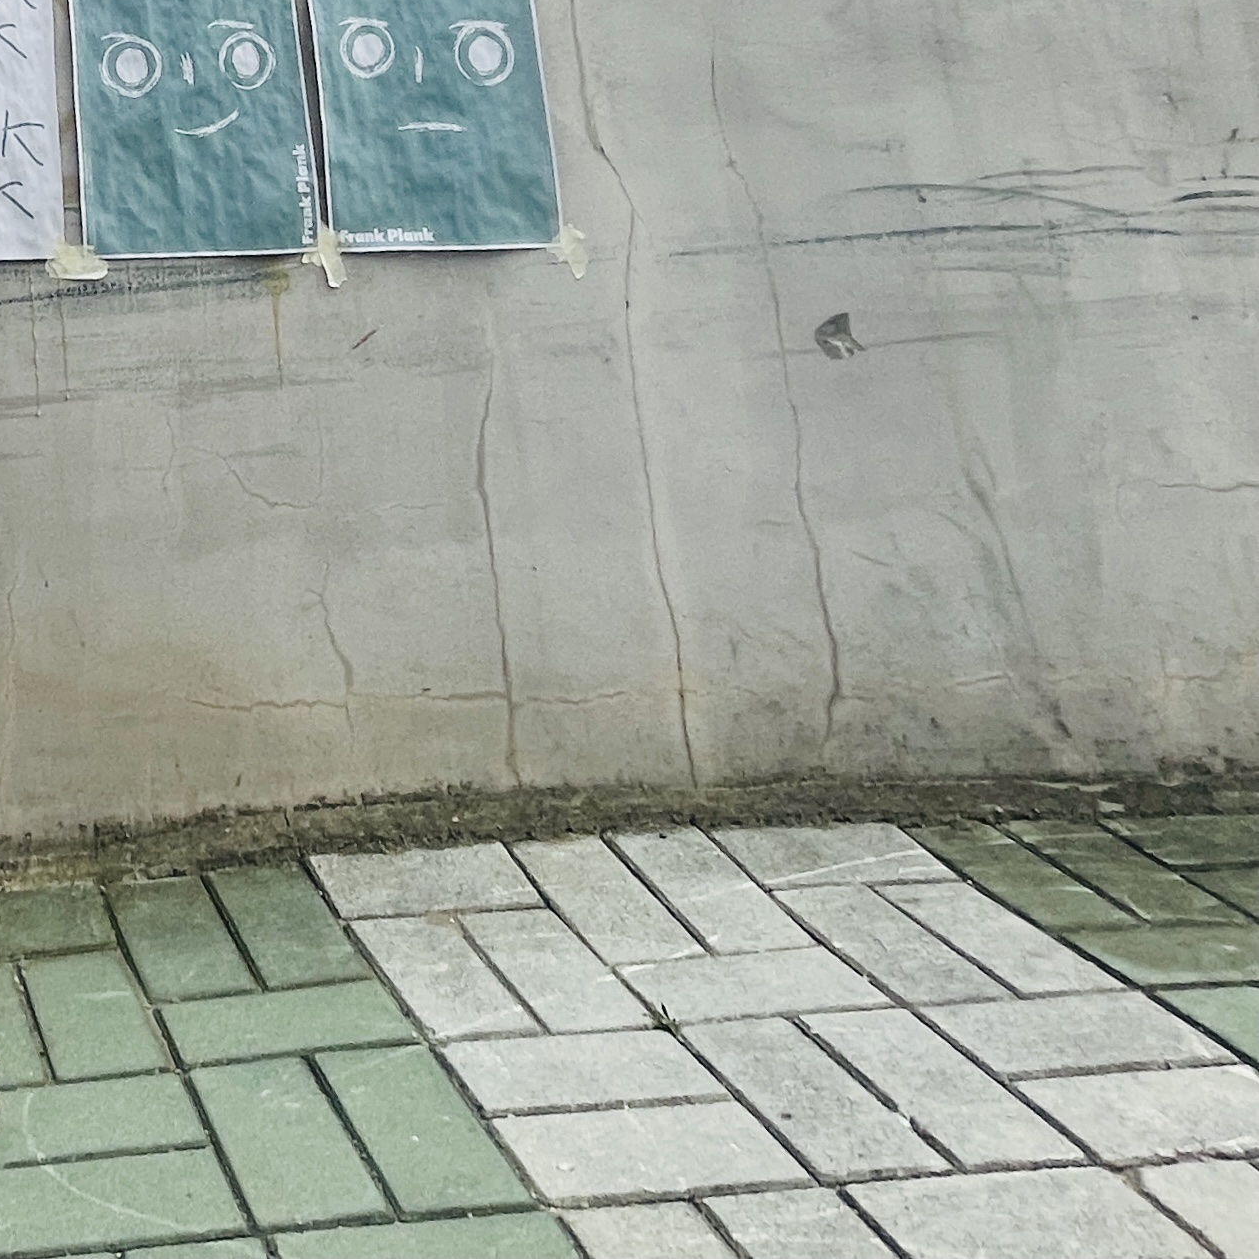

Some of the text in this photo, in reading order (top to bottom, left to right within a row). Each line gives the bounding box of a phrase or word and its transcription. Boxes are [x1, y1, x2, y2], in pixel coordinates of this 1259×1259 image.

[292, 143, 315, 245] Frank Plank
[339, 227, 436, 243] Frank Plank
